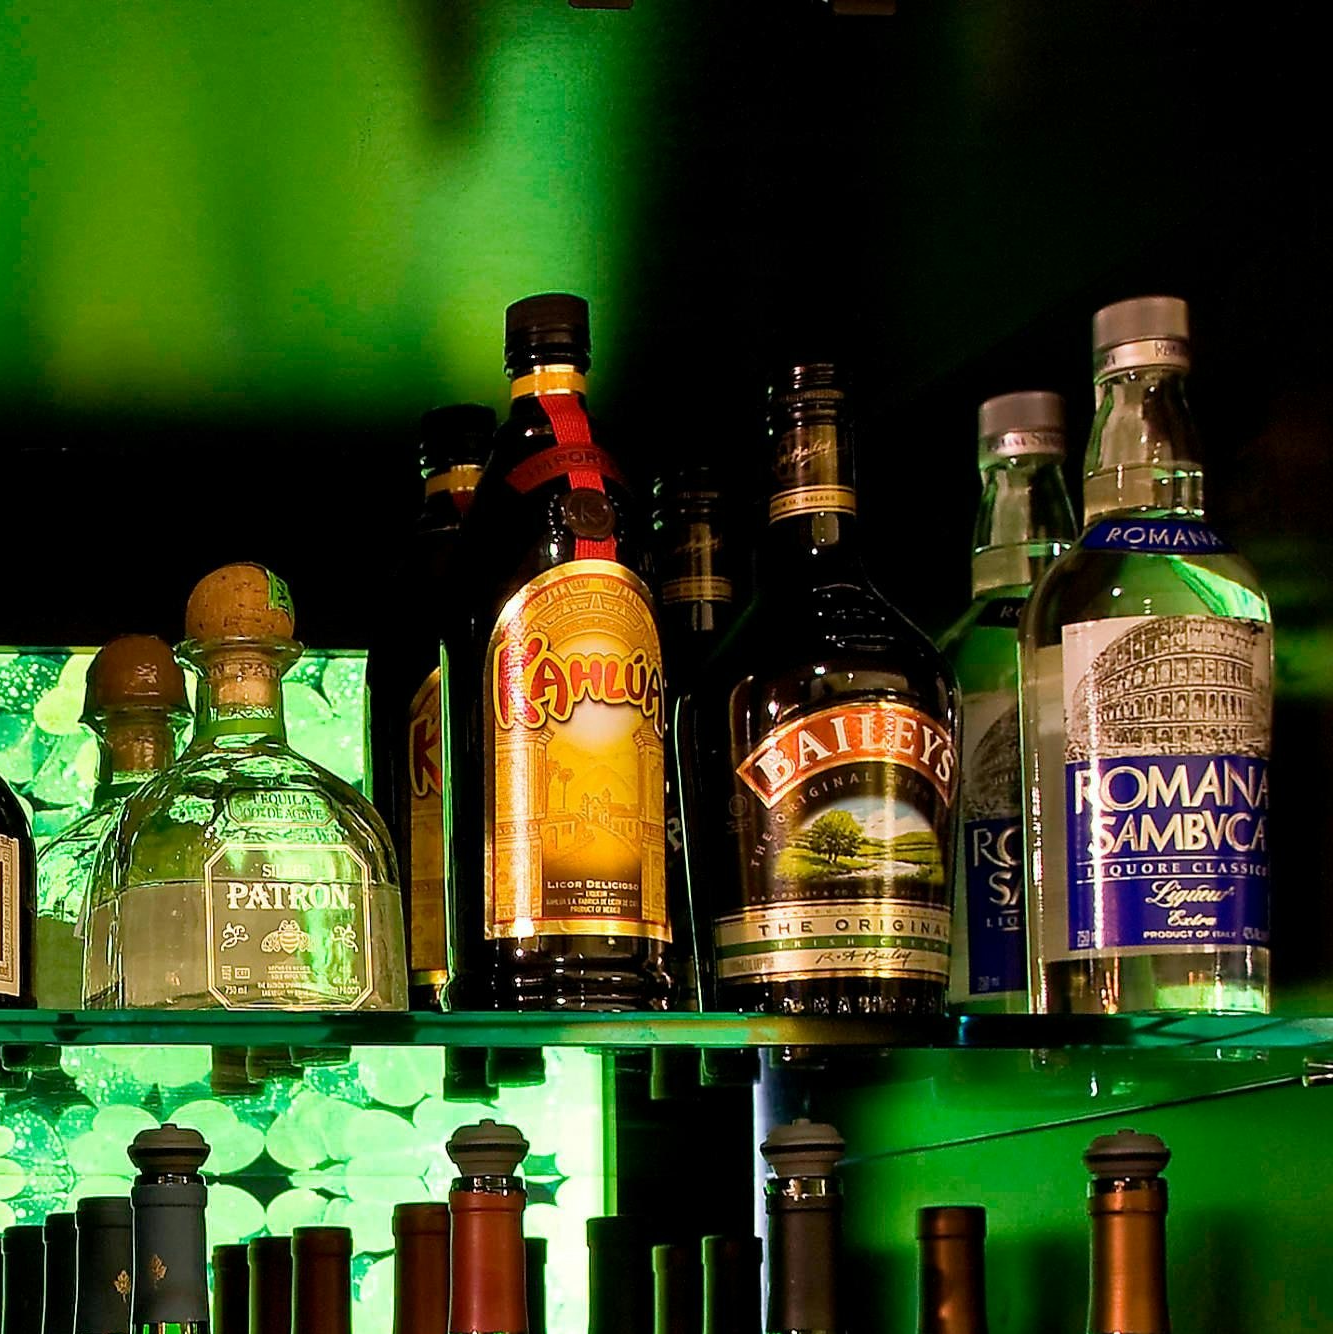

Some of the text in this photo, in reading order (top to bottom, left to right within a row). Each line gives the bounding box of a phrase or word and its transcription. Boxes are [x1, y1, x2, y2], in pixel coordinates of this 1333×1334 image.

[1105, 526, 1224, 547] ROMANA
[755, 713, 955, 794] BAILEYS
[1072, 759, 1272, 813] ROMANA
[253, 793, 312, 804] TEQUILA
[1087, 862, 1181, 877] LQUORE
[547, 880, 639, 891] LICOR DELICIOSO
[758, 919, 949, 937] THE ORIGINAL
[1143, 930, 1193, 939] PRODUCT
